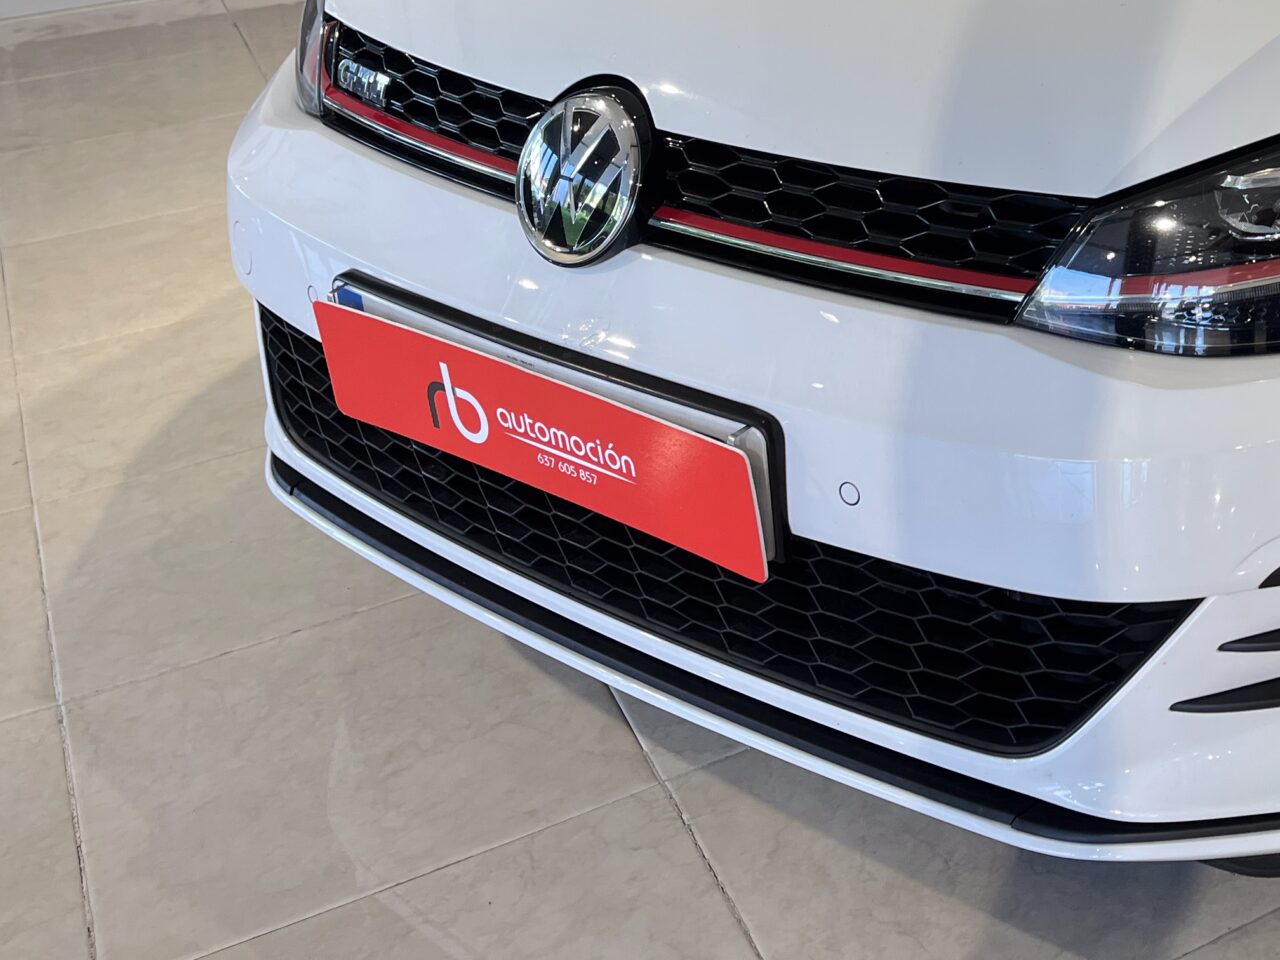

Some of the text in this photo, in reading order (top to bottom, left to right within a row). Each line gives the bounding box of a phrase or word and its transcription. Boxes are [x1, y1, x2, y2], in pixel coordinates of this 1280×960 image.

[496, 407, 637, 478] automoción
[537, 452, 598, 486] 637 605 857
